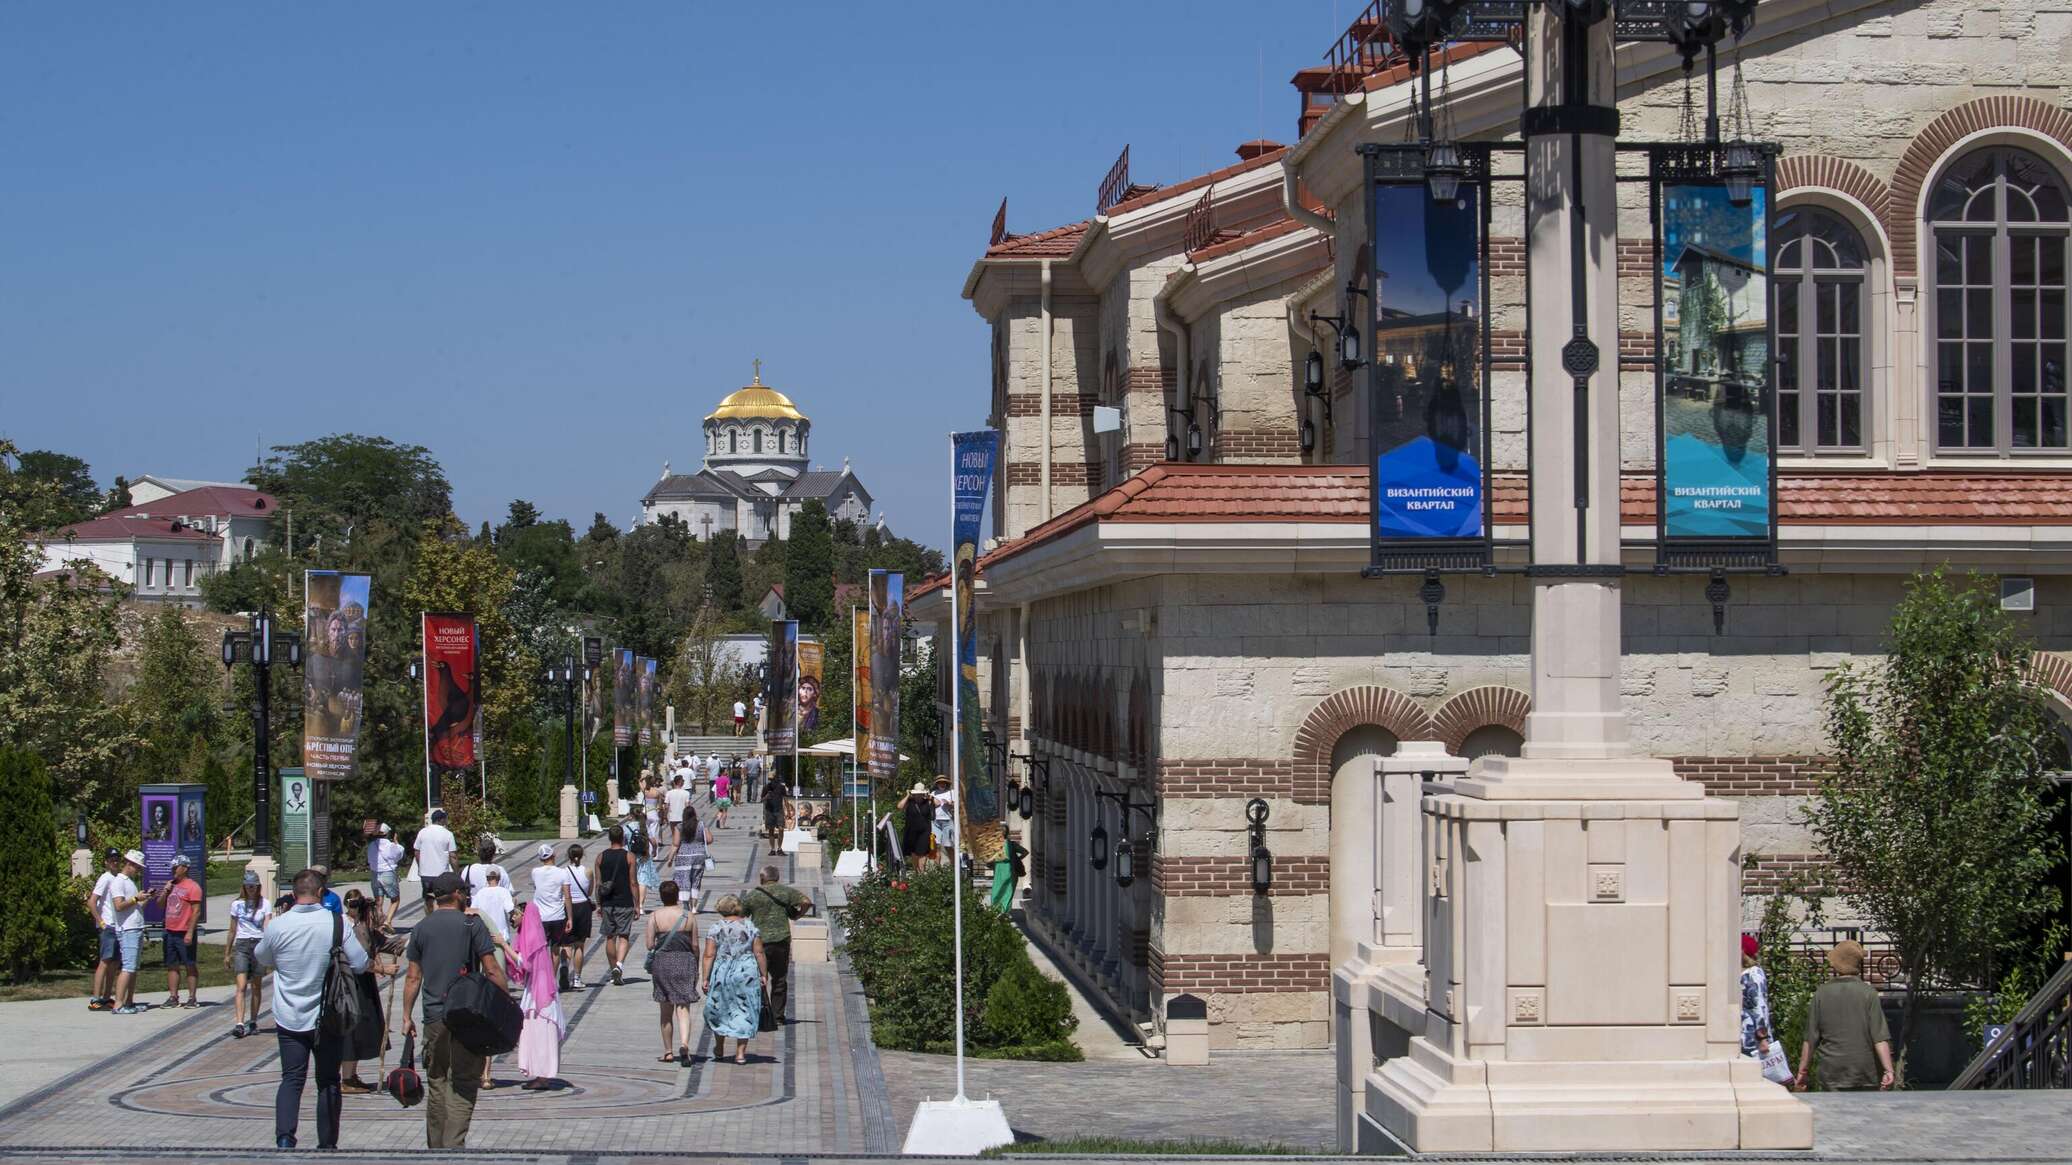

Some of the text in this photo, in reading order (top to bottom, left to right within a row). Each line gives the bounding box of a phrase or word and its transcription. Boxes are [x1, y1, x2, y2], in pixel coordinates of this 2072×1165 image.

[1387, 486, 1474, 497] ВИЗАНТИЙСКИЙ
[1674, 485, 1760, 496] ВИЗАНТИЙСКИЙ
[1407, 501, 1455, 510] КВАРТАЛ
[1694, 499, 1741, 508] КВАРТАЛ
[439, 626, 465, 635] НОВЫЙ
[434, 635, 470, 643] ХЕРСОНЕС
